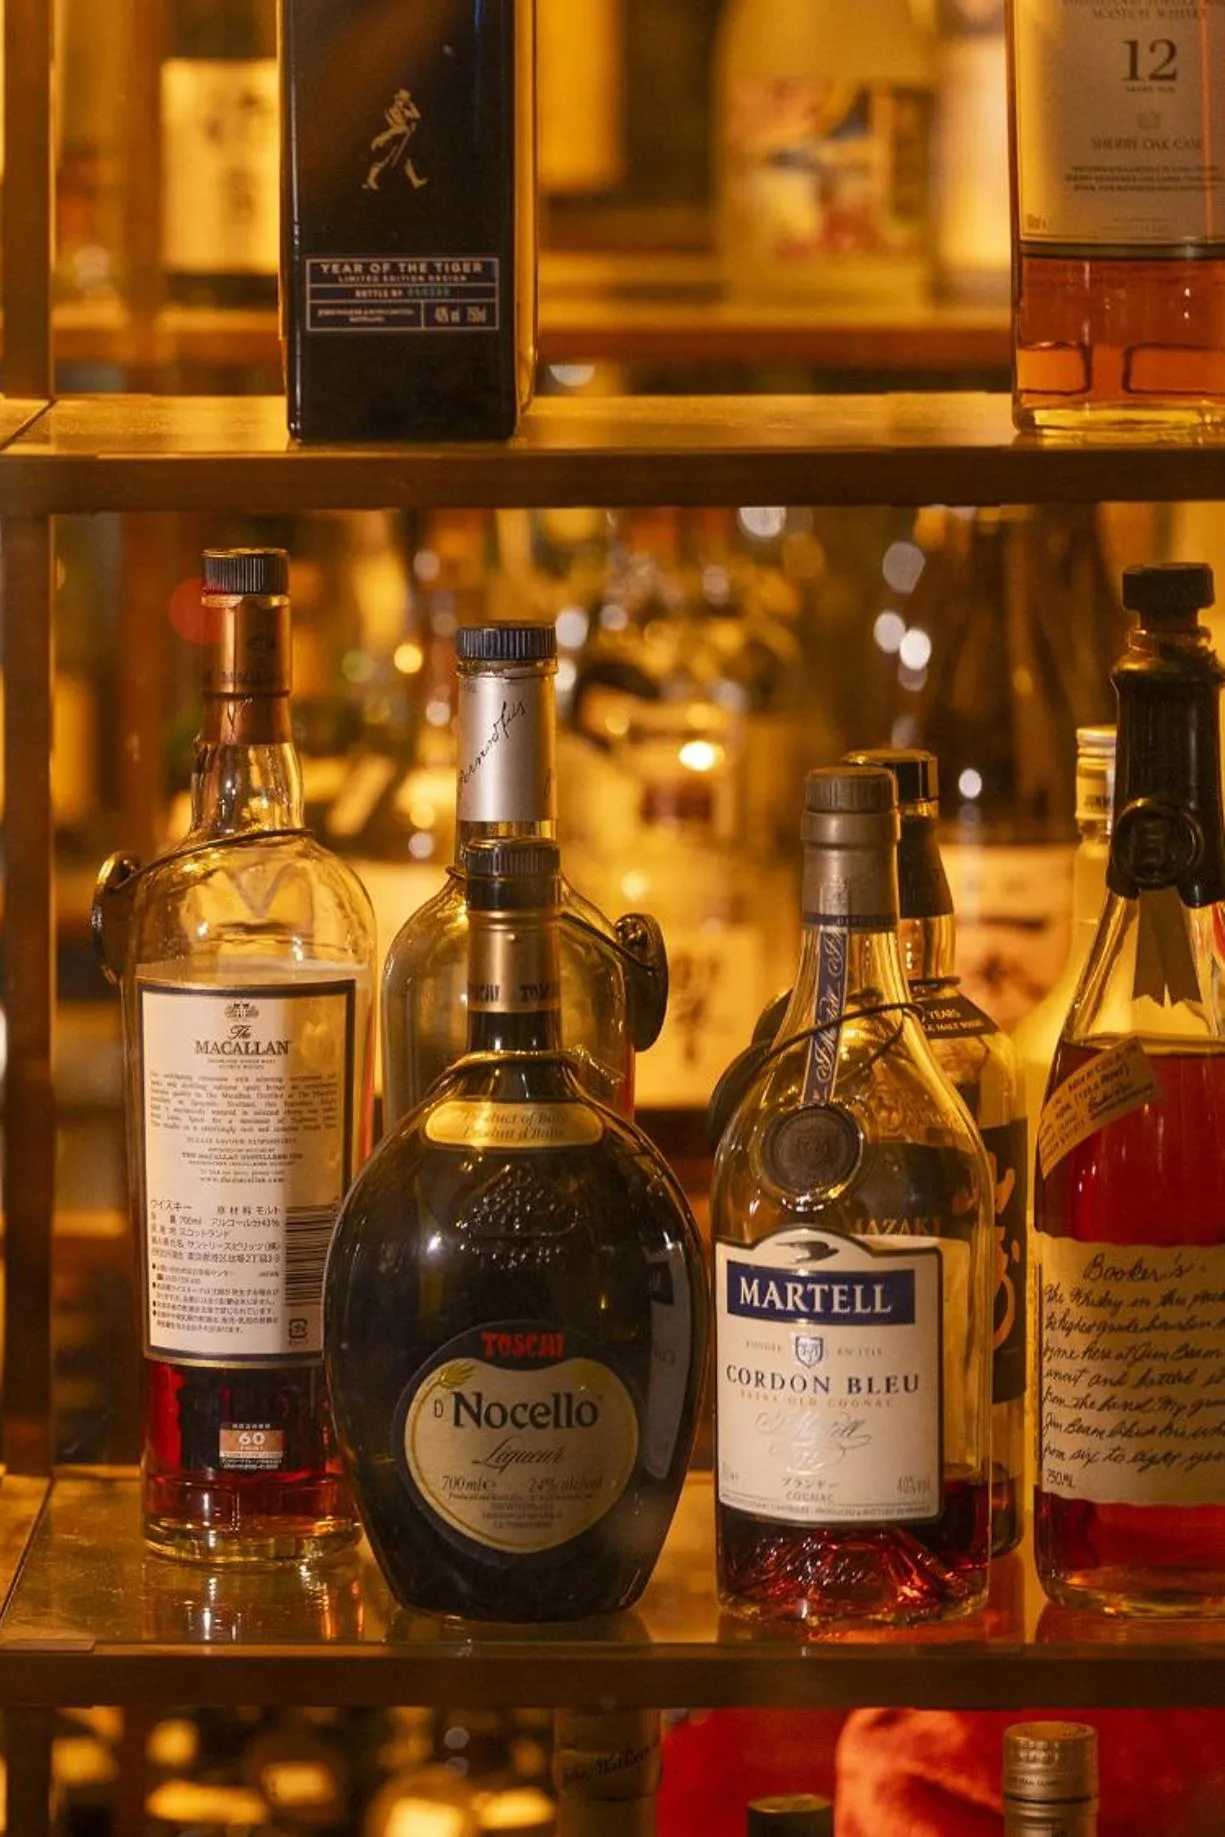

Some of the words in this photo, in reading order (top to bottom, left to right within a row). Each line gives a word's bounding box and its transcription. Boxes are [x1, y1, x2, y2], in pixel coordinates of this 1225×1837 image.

[1121, 38, 1178, 82] 12
[319, 262, 364, 274] YEAR
[369, 263, 391, 274] OF
[397, 263, 428, 274] THE
[434, 262, 484, 274] TIGER
[227, 1024, 252, 1041] The
[194, 1039, 291, 1056] MACALLAN
[151, 1199, 193, 1212] ウイスキー
[738, 1275, 893, 1314] MARTELL
[481, 1331, 567, 1359] TOSCHI
[725, 1363, 831, 1394] CORDON
[846, 1373, 919, 1395] BLEU
[451, 1391, 599, 1430] Nocello
[238, 1431, 266, 1446] 60
[472, 1436, 567, 1475] Liqueur
